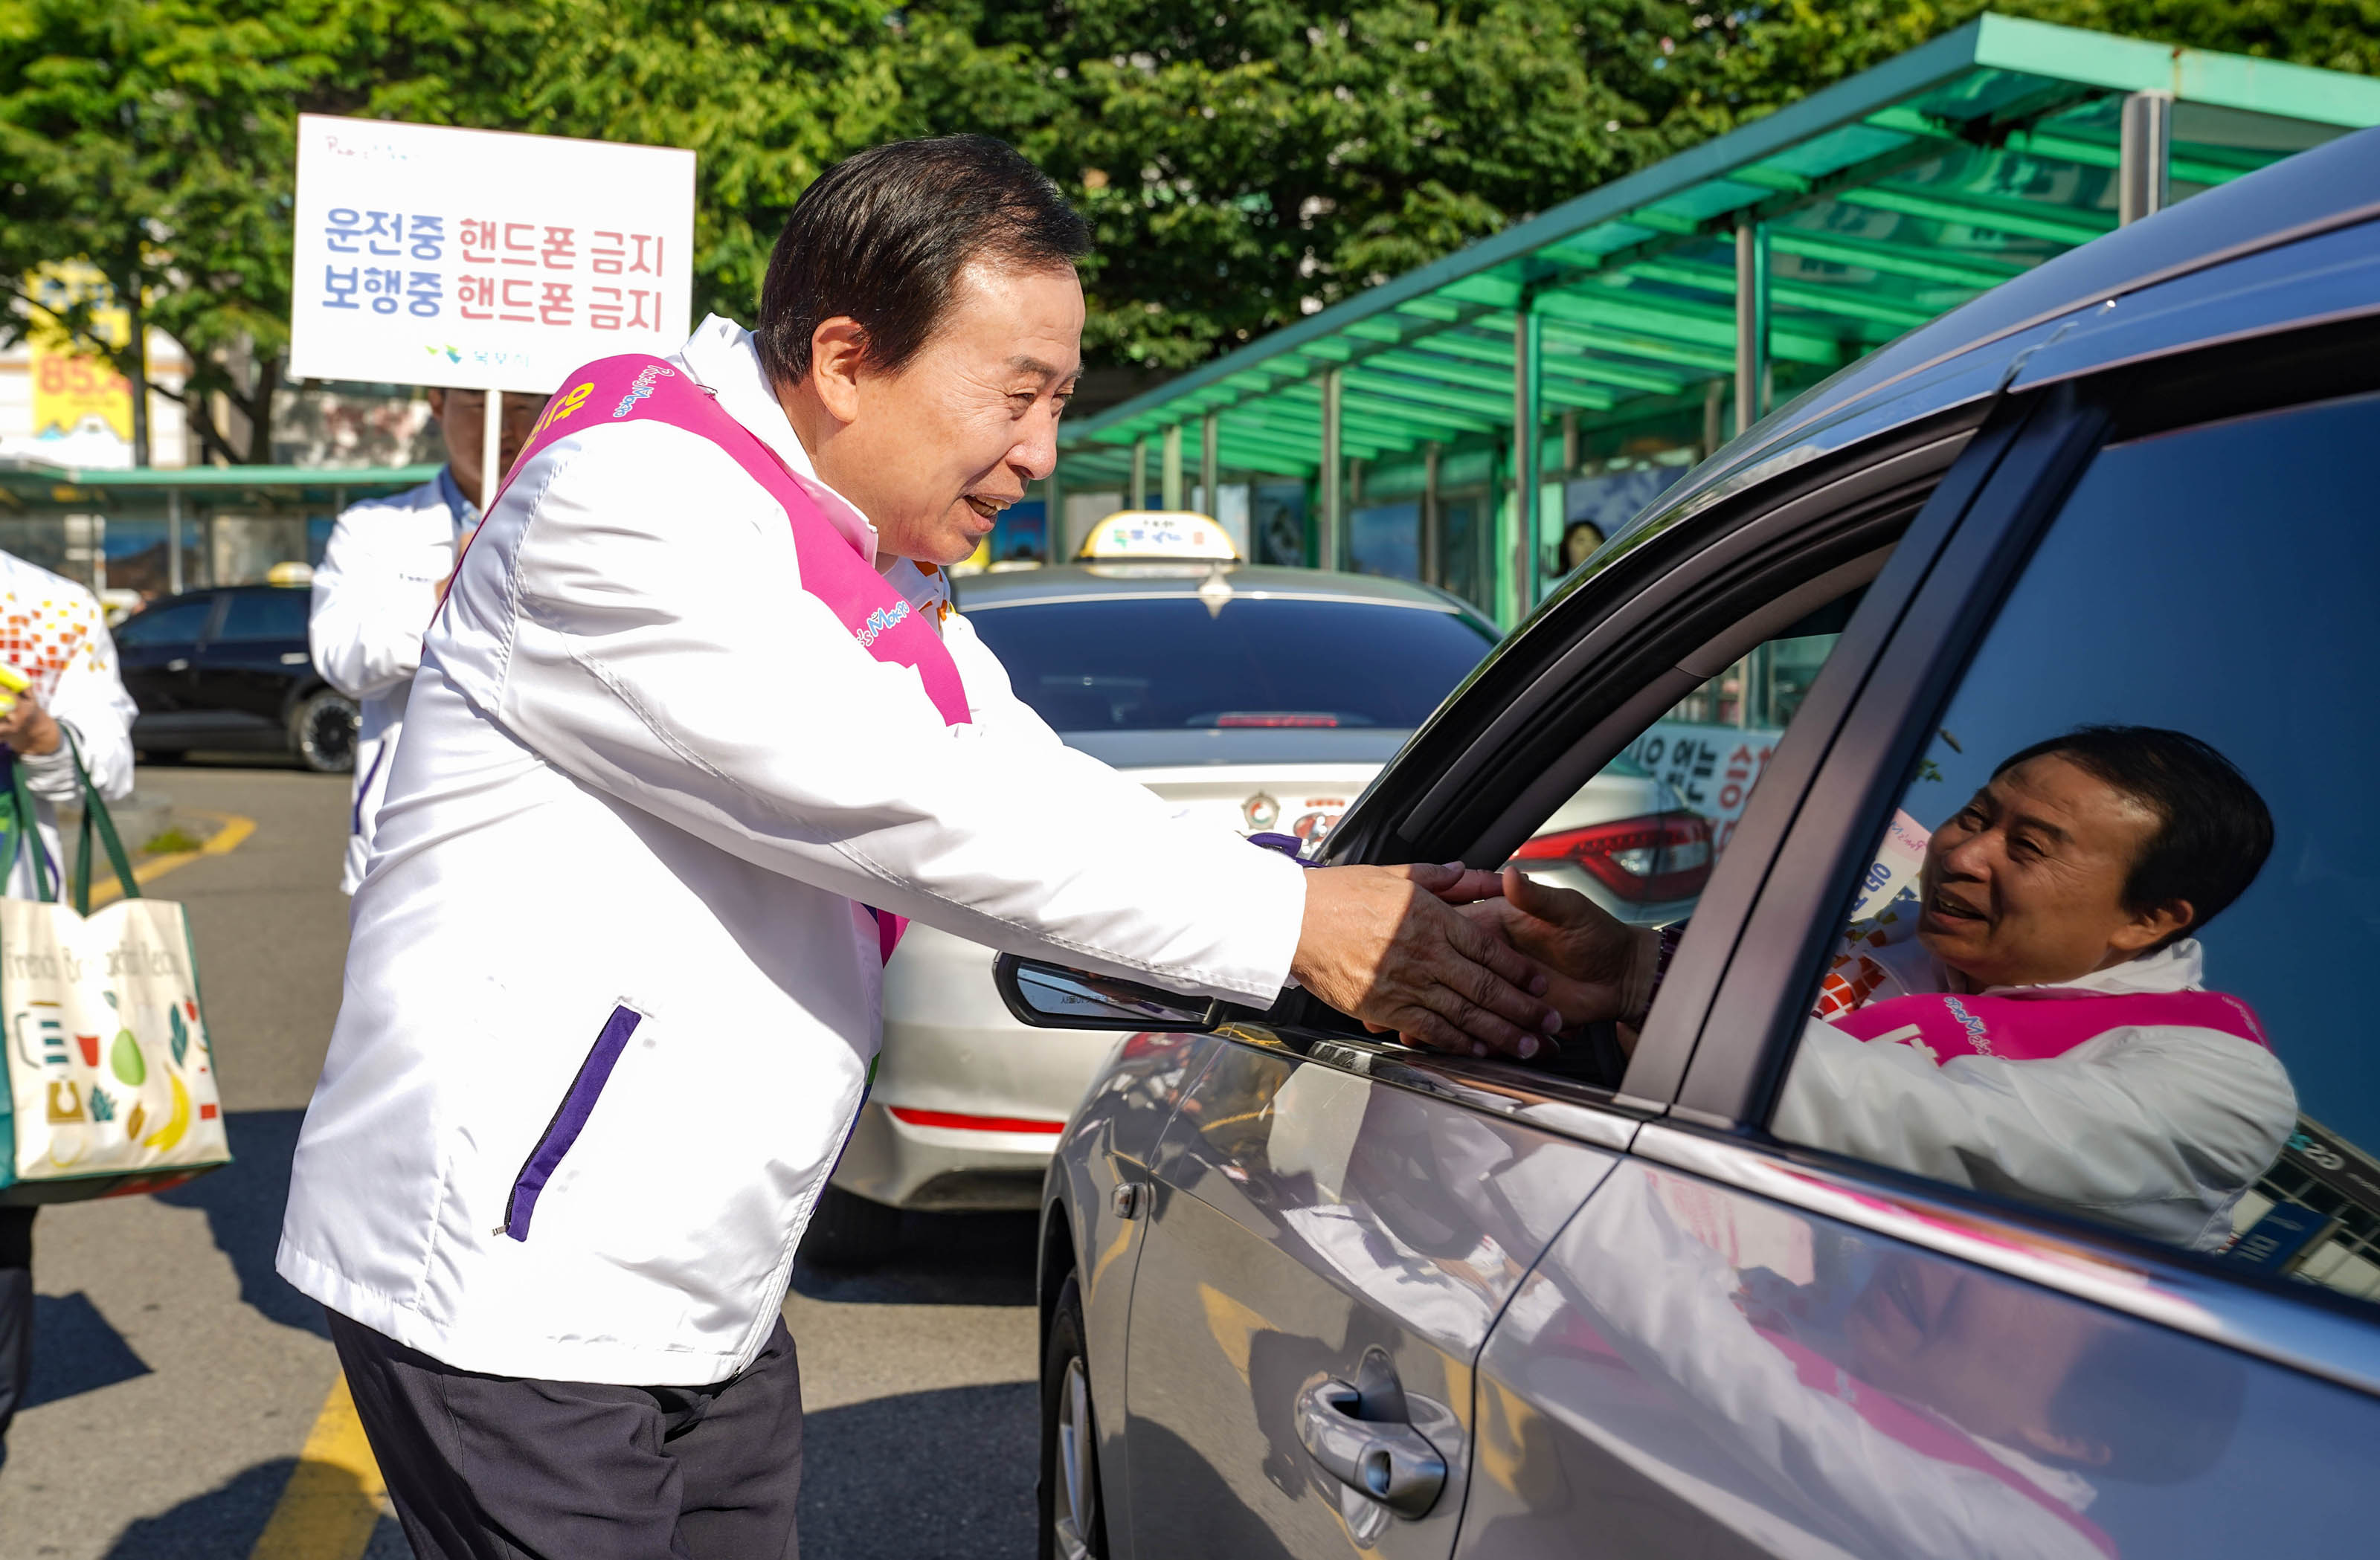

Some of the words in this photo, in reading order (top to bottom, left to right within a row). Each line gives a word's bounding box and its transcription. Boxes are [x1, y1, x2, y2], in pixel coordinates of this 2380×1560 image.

[324, 207, 446, 261] 운전중
[459, 218, 576, 270] 핸드폰
[590, 231, 663, 277] 금지
[321, 264, 444, 318] 보행중
[457, 274, 575, 326] 핸드폰
[588, 286, 662, 332] 금지
